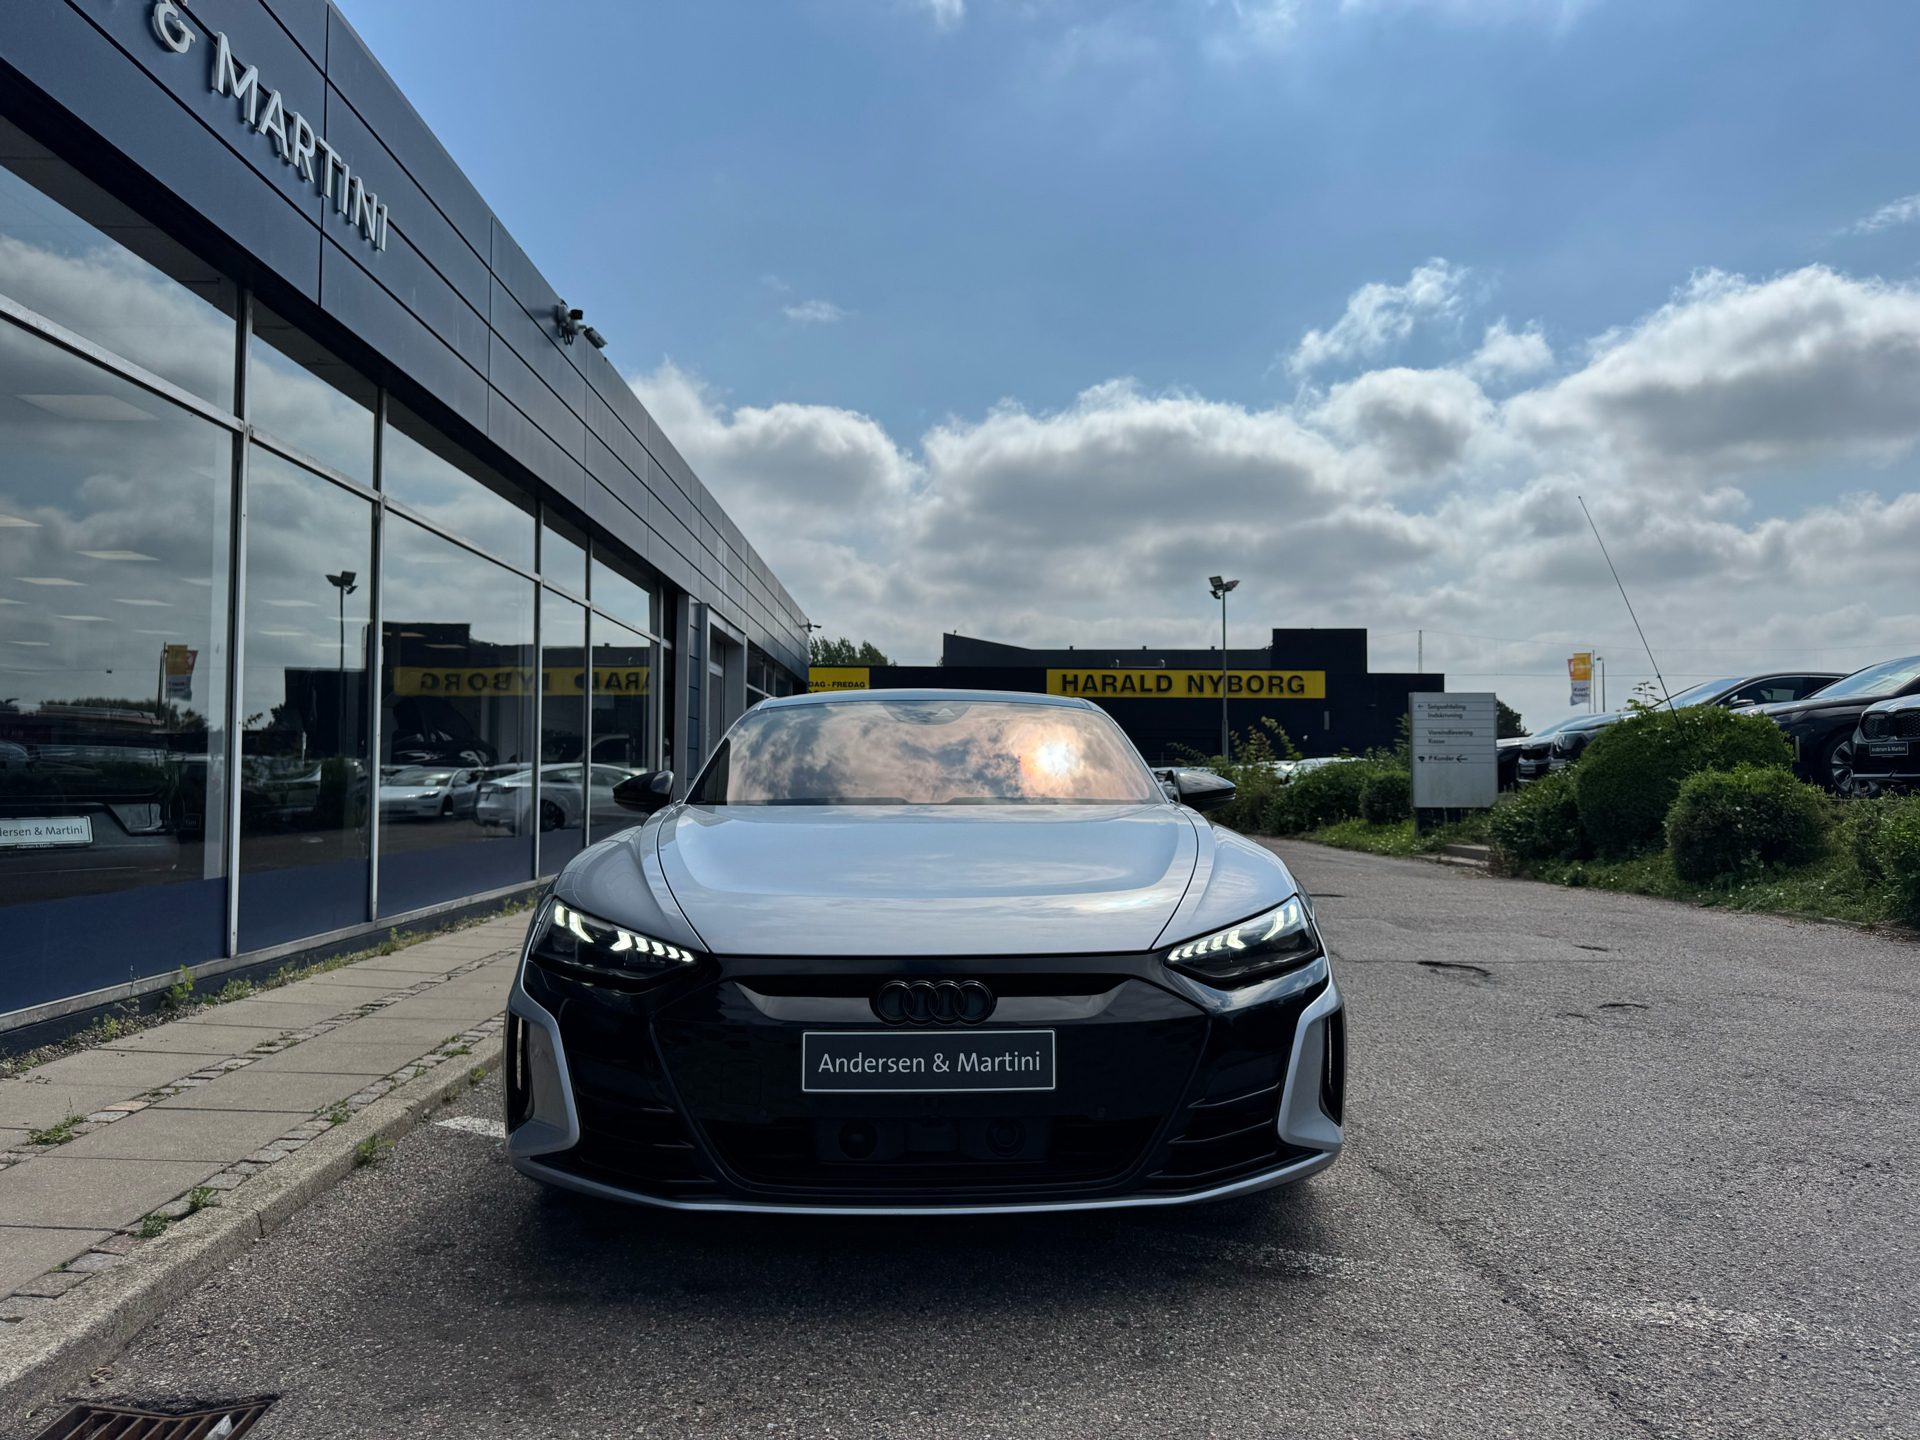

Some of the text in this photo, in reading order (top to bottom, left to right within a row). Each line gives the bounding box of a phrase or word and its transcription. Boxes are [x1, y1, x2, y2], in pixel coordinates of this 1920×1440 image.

[213, 32, 388, 252] MARTINI
[1061, 674, 1305, 693] HARALD NYBORG
[1427, 703, 1467, 711] Salgsafdeling
[34, 826, 43, 836] &
[45, 825, 83, 835] Martini
[818, 1051, 1041, 1073] Andersen & Martini
